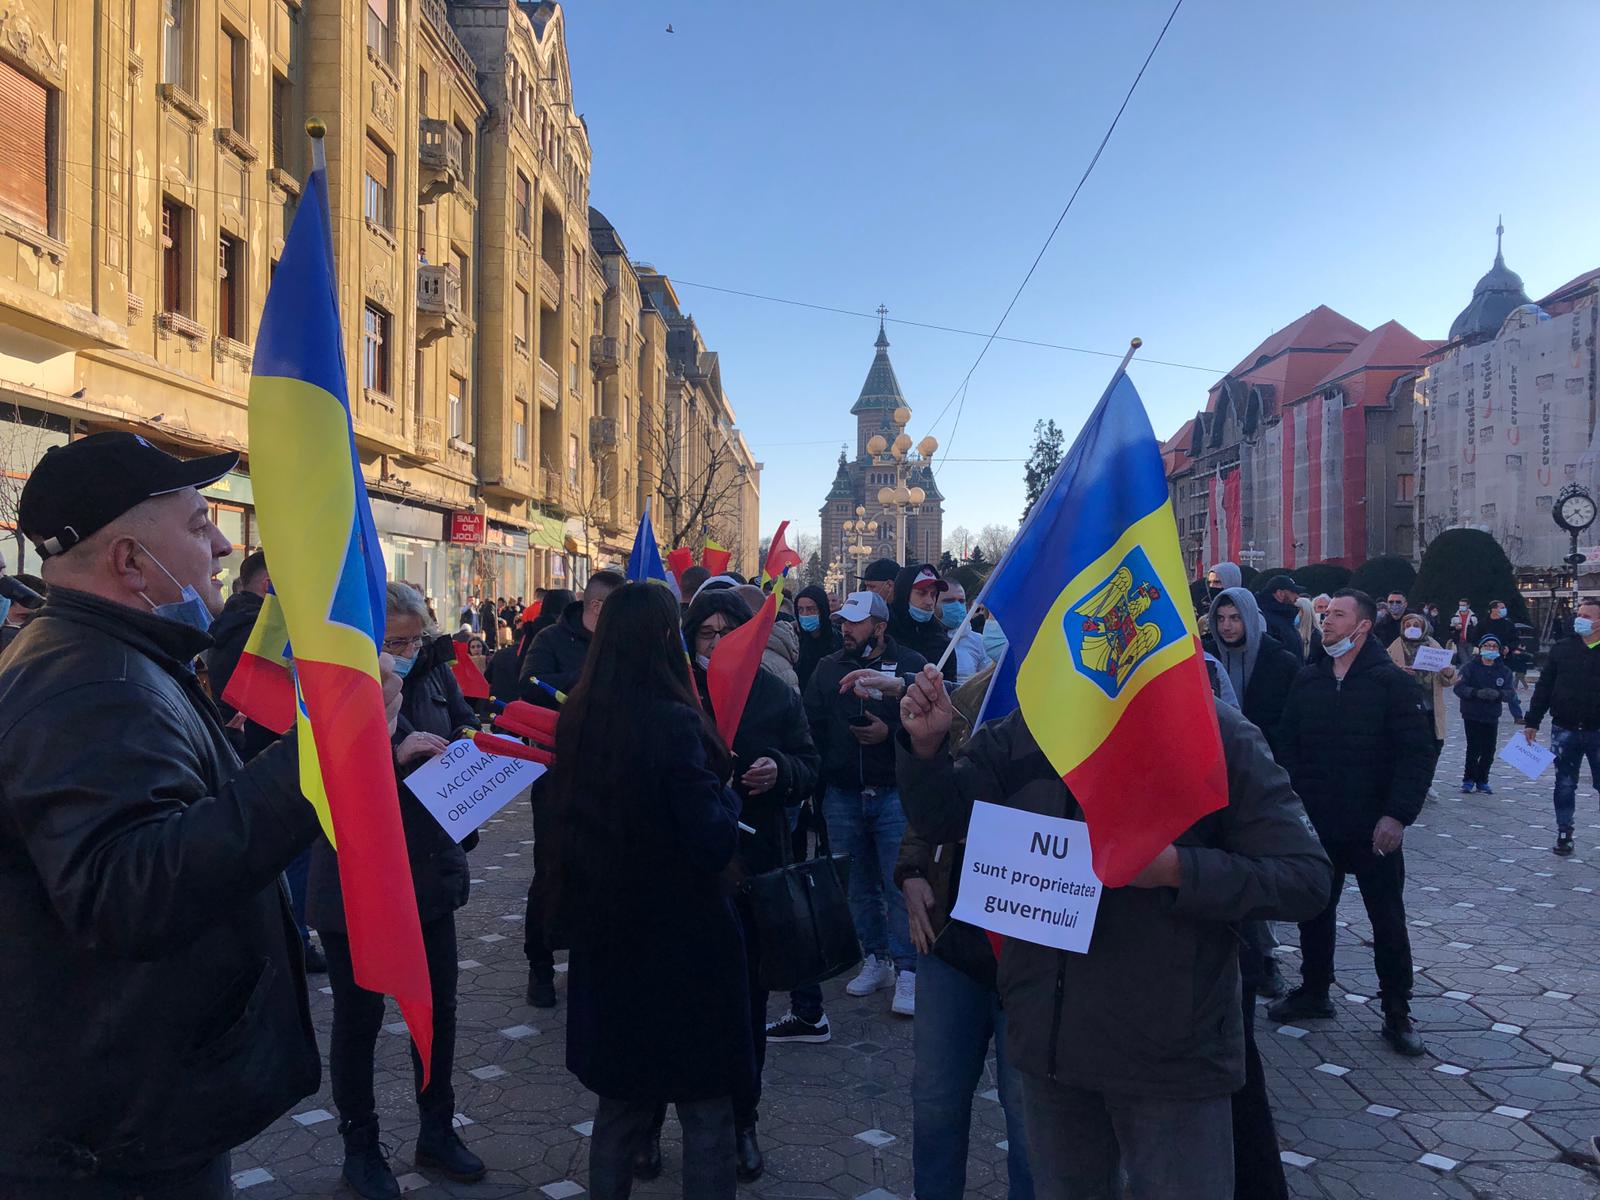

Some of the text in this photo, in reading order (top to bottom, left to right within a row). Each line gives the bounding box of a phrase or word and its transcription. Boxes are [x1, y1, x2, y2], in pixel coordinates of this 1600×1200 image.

[457, 515, 480, 523] SALA
[462, 524, 475, 532] DE
[453, 533, 483, 541] JOCURI
[440, 742, 471, 769] STOP
[448, 758, 524, 822] OBLIGATORIE
[1030, 831, 1069, 860] NU
[972, 861, 1096, 898] sunt proprietatea
[984, 895, 1079, 929] guvernului
